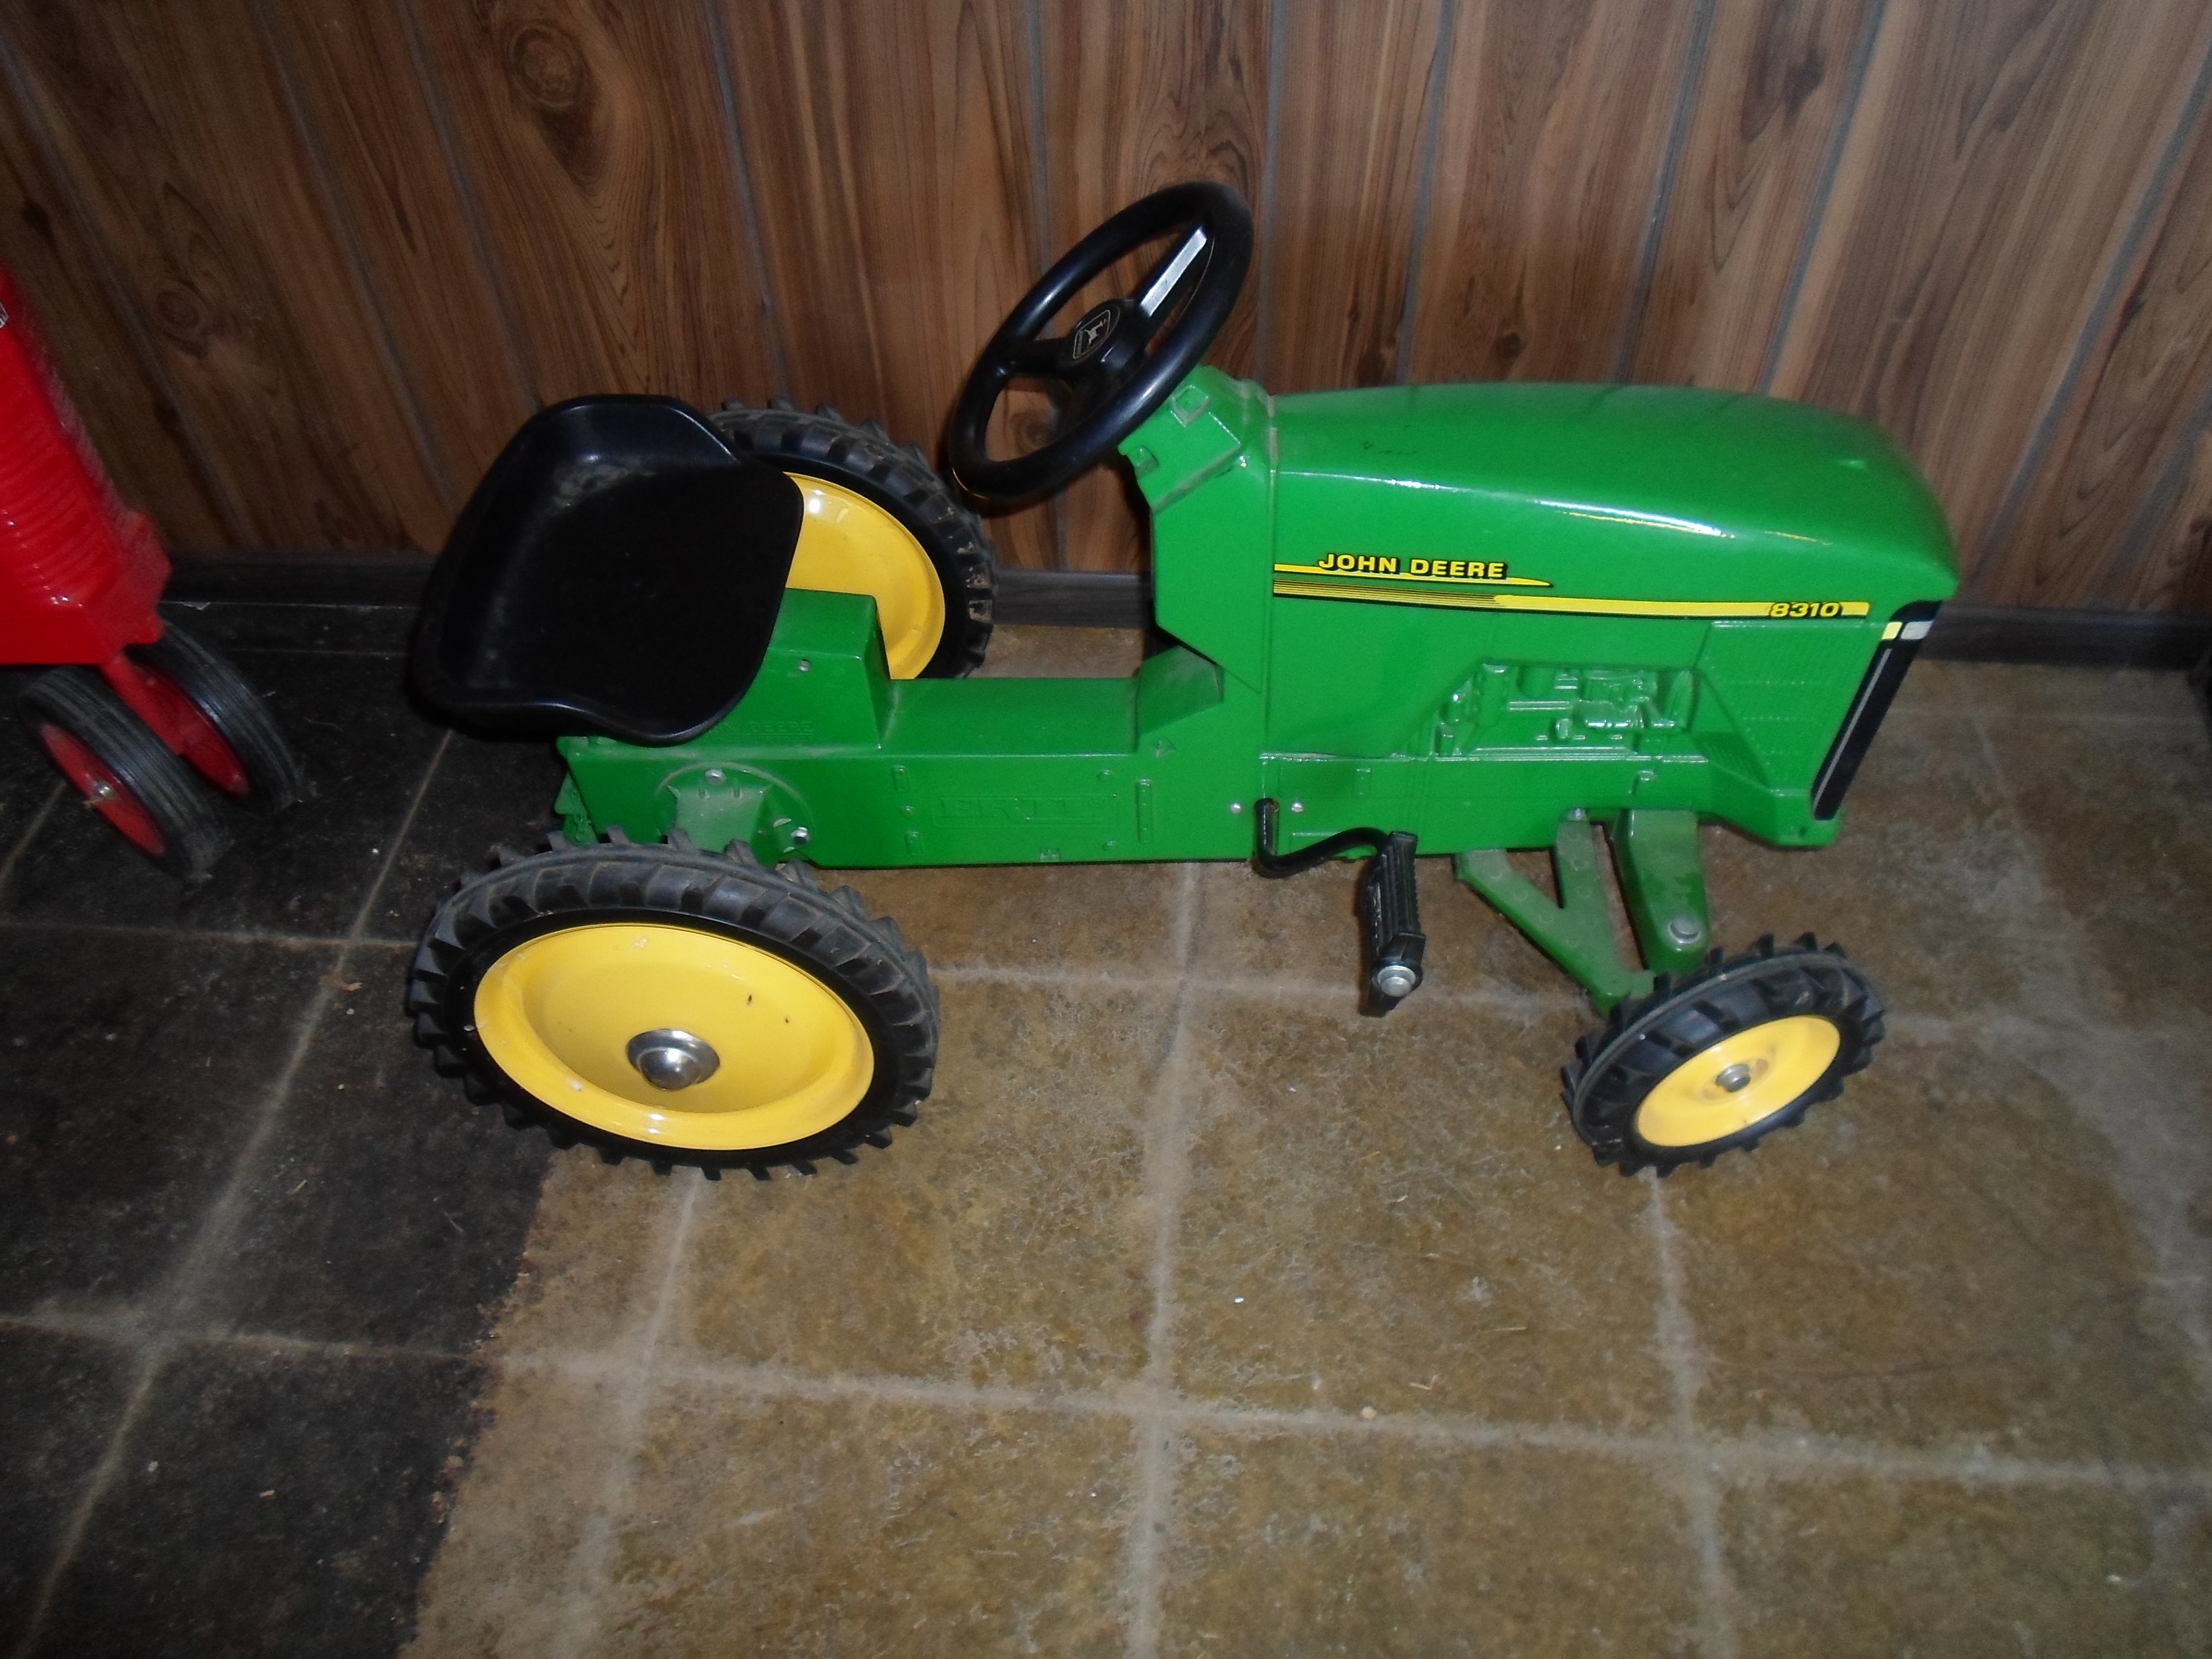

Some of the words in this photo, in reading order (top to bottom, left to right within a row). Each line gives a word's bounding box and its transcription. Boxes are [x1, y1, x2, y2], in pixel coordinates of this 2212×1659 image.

[1318, 553, 1399, 574] JOHN
[1409, 558, 1506, 579] DEERE
[1769, 602, 1842, 618] 8310
